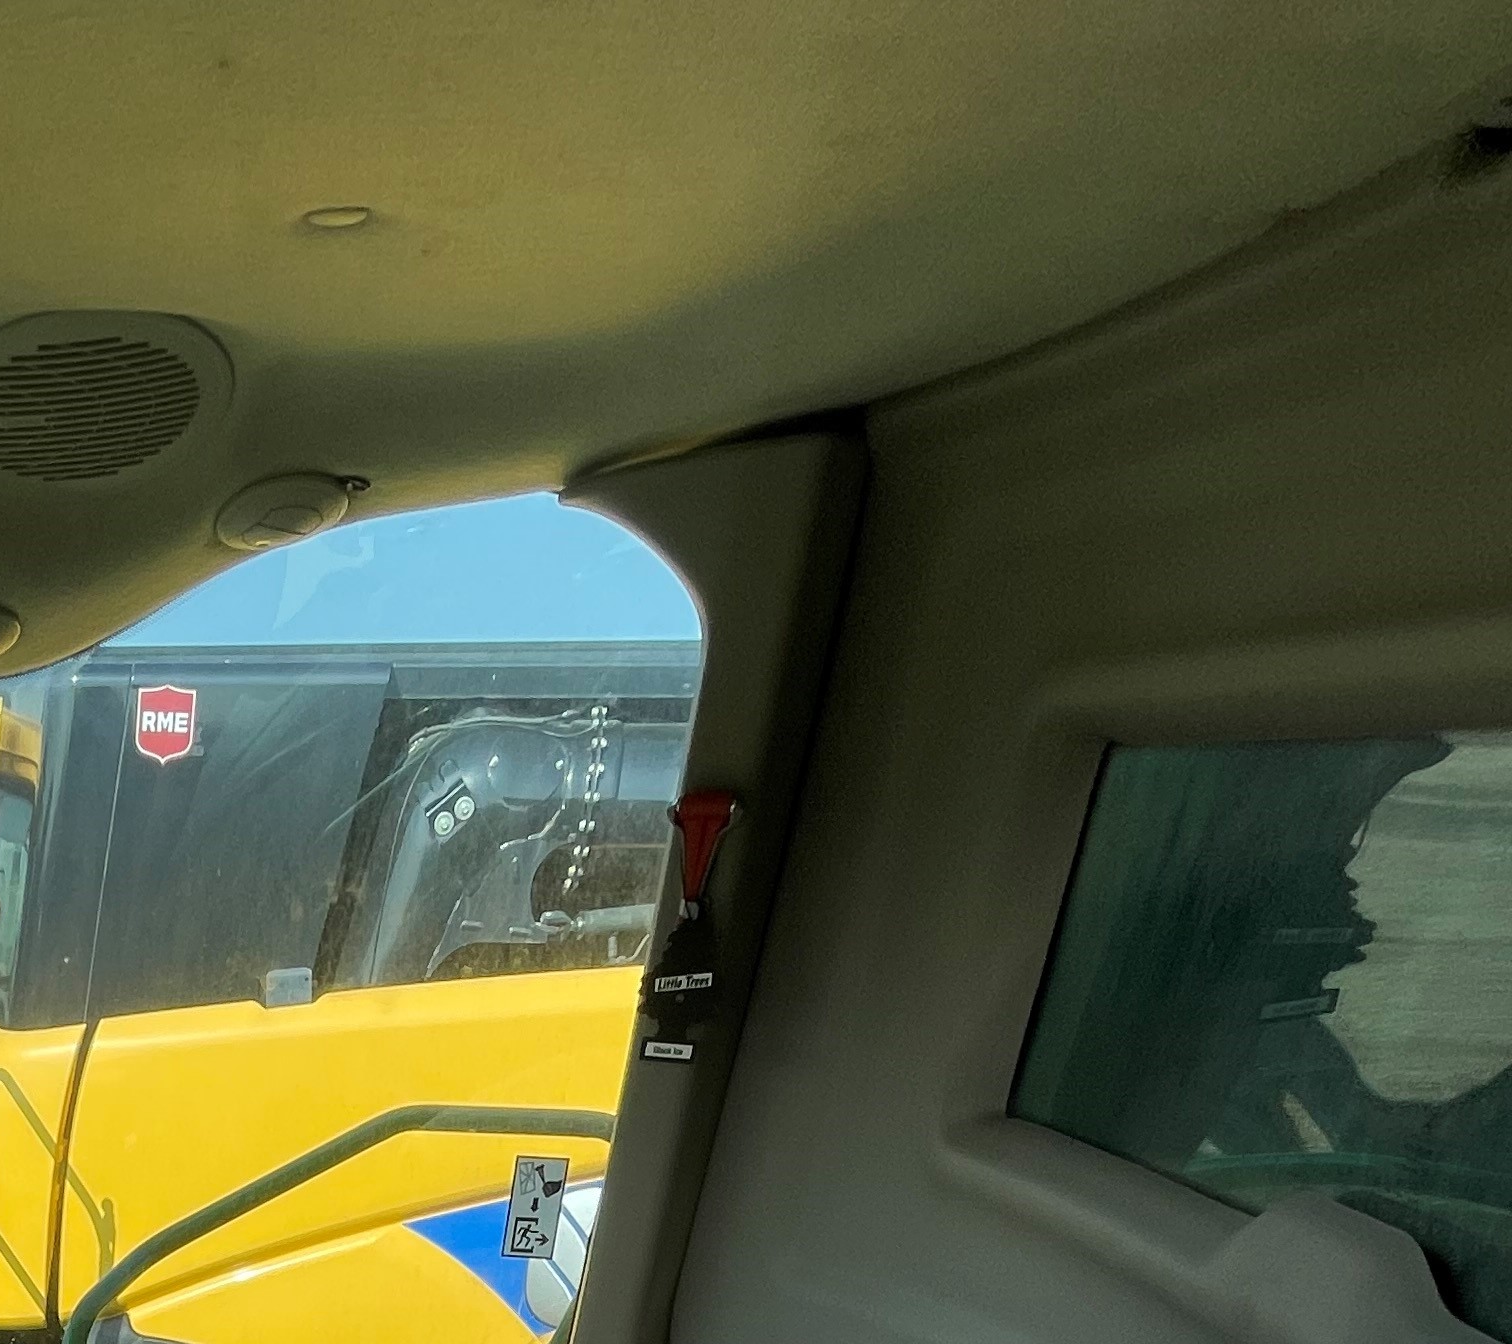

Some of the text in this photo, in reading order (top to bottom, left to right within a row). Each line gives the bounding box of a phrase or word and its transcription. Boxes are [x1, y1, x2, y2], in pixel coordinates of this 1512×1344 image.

[141, 710, 189, 734] RME
[658, 974, 710, 990] Little Trees
